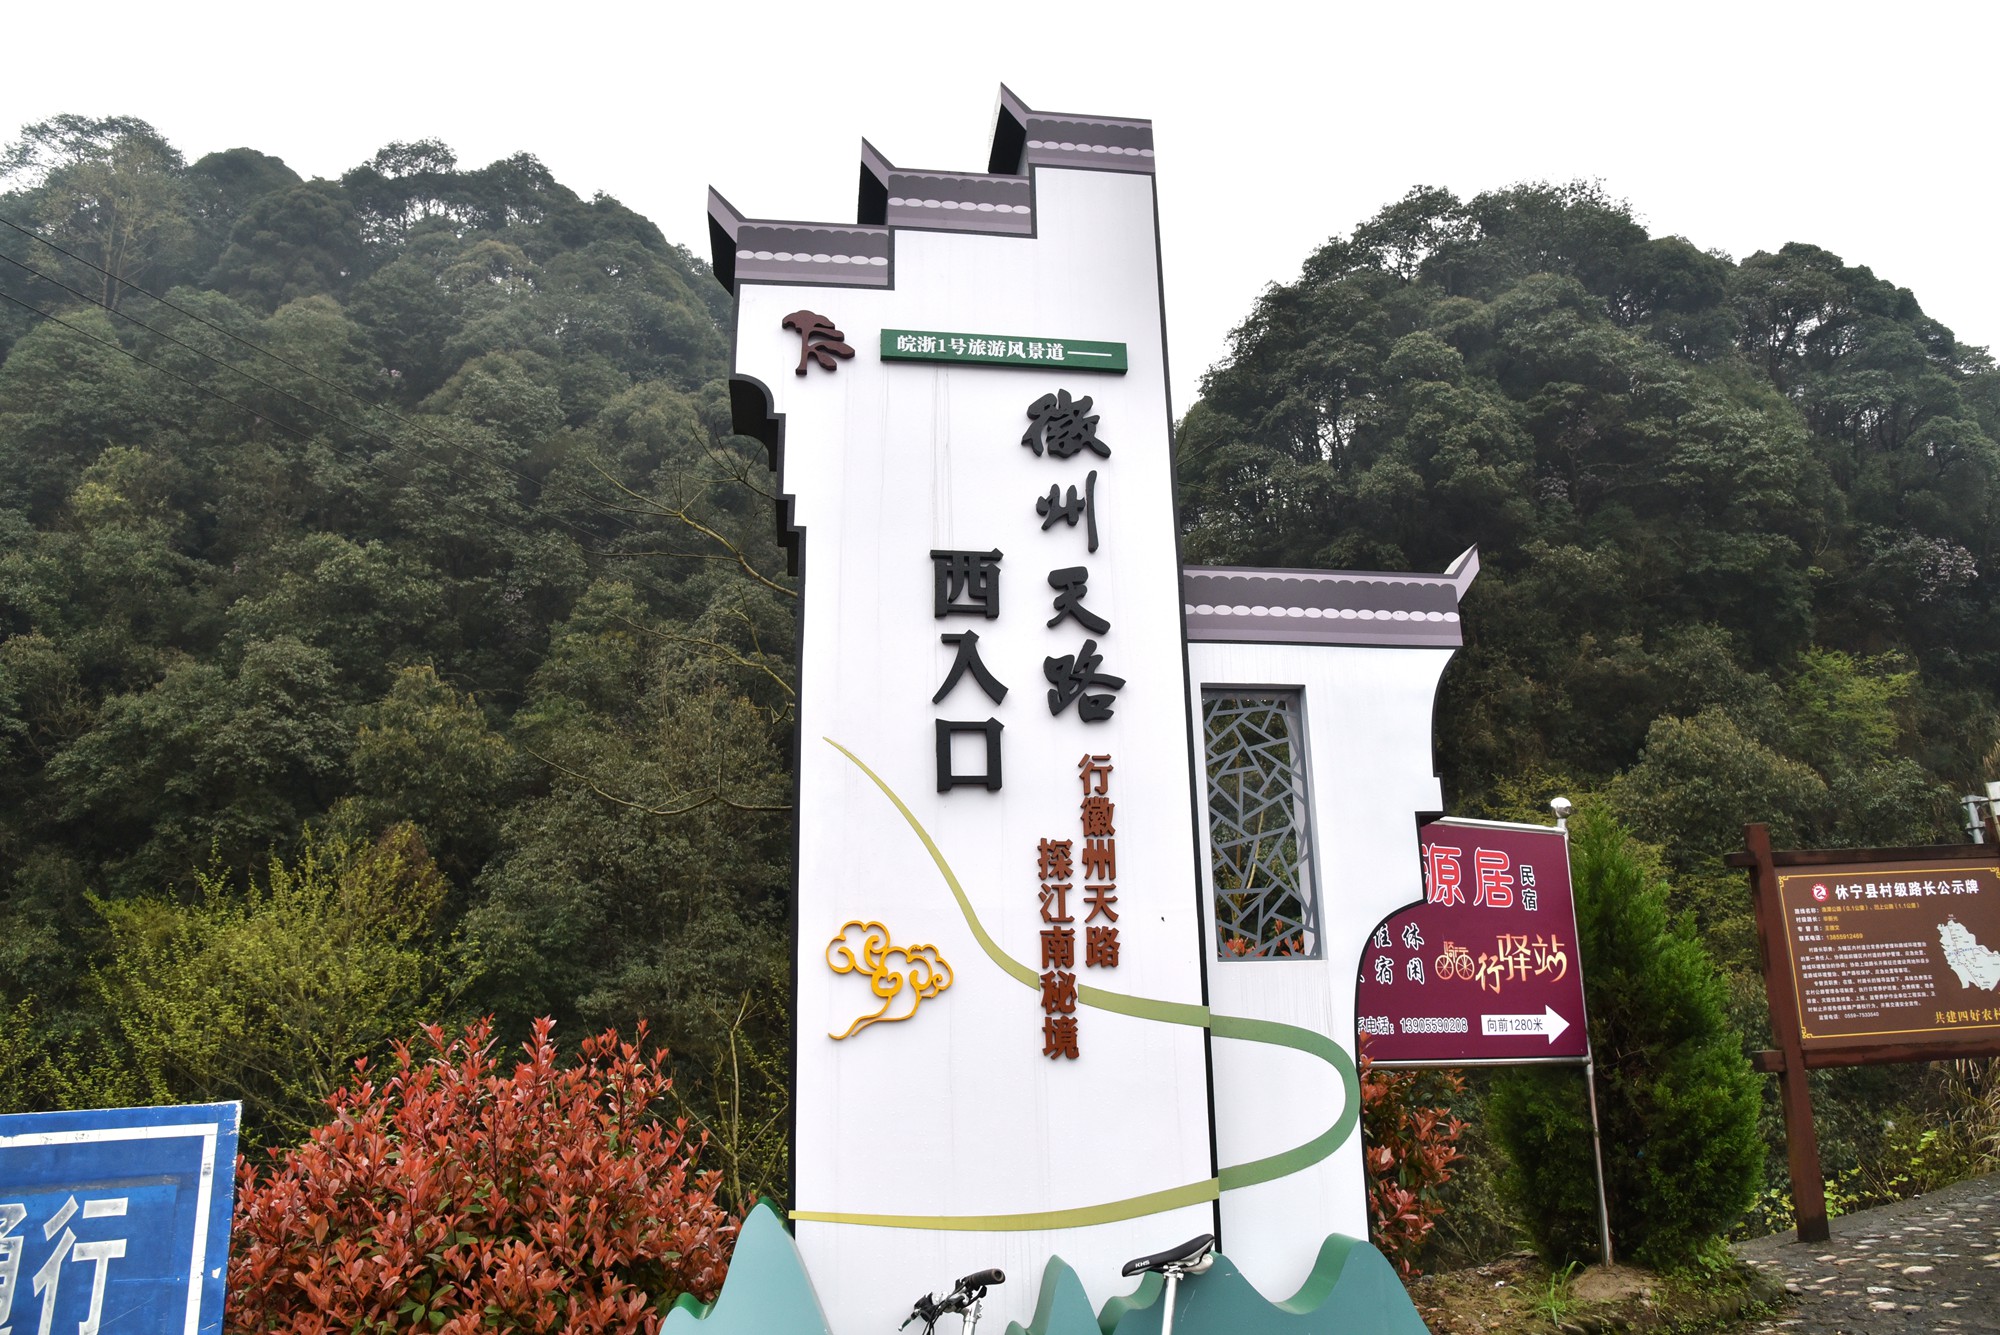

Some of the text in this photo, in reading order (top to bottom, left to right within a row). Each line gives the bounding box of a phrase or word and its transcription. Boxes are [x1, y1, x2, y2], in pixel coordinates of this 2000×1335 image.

[1021, 388, 1127, 723] 徽州天路
[929, 547, 1009, 793] 西入口
[1077, 753, 1121, 969] 行徽州天路
[1519, 864, 1538, 912] 民宿
[1835, 878, 1980, 901] 休宁县村级路长公示牌
[1036, 837, 1080, 1060] 探江南秘境
[1400, 1017, 1469, 1034] 13905590208
[1486, 1017, 1544, 1033] 向前1280米
[0, 1194, 129, 1335] 行
